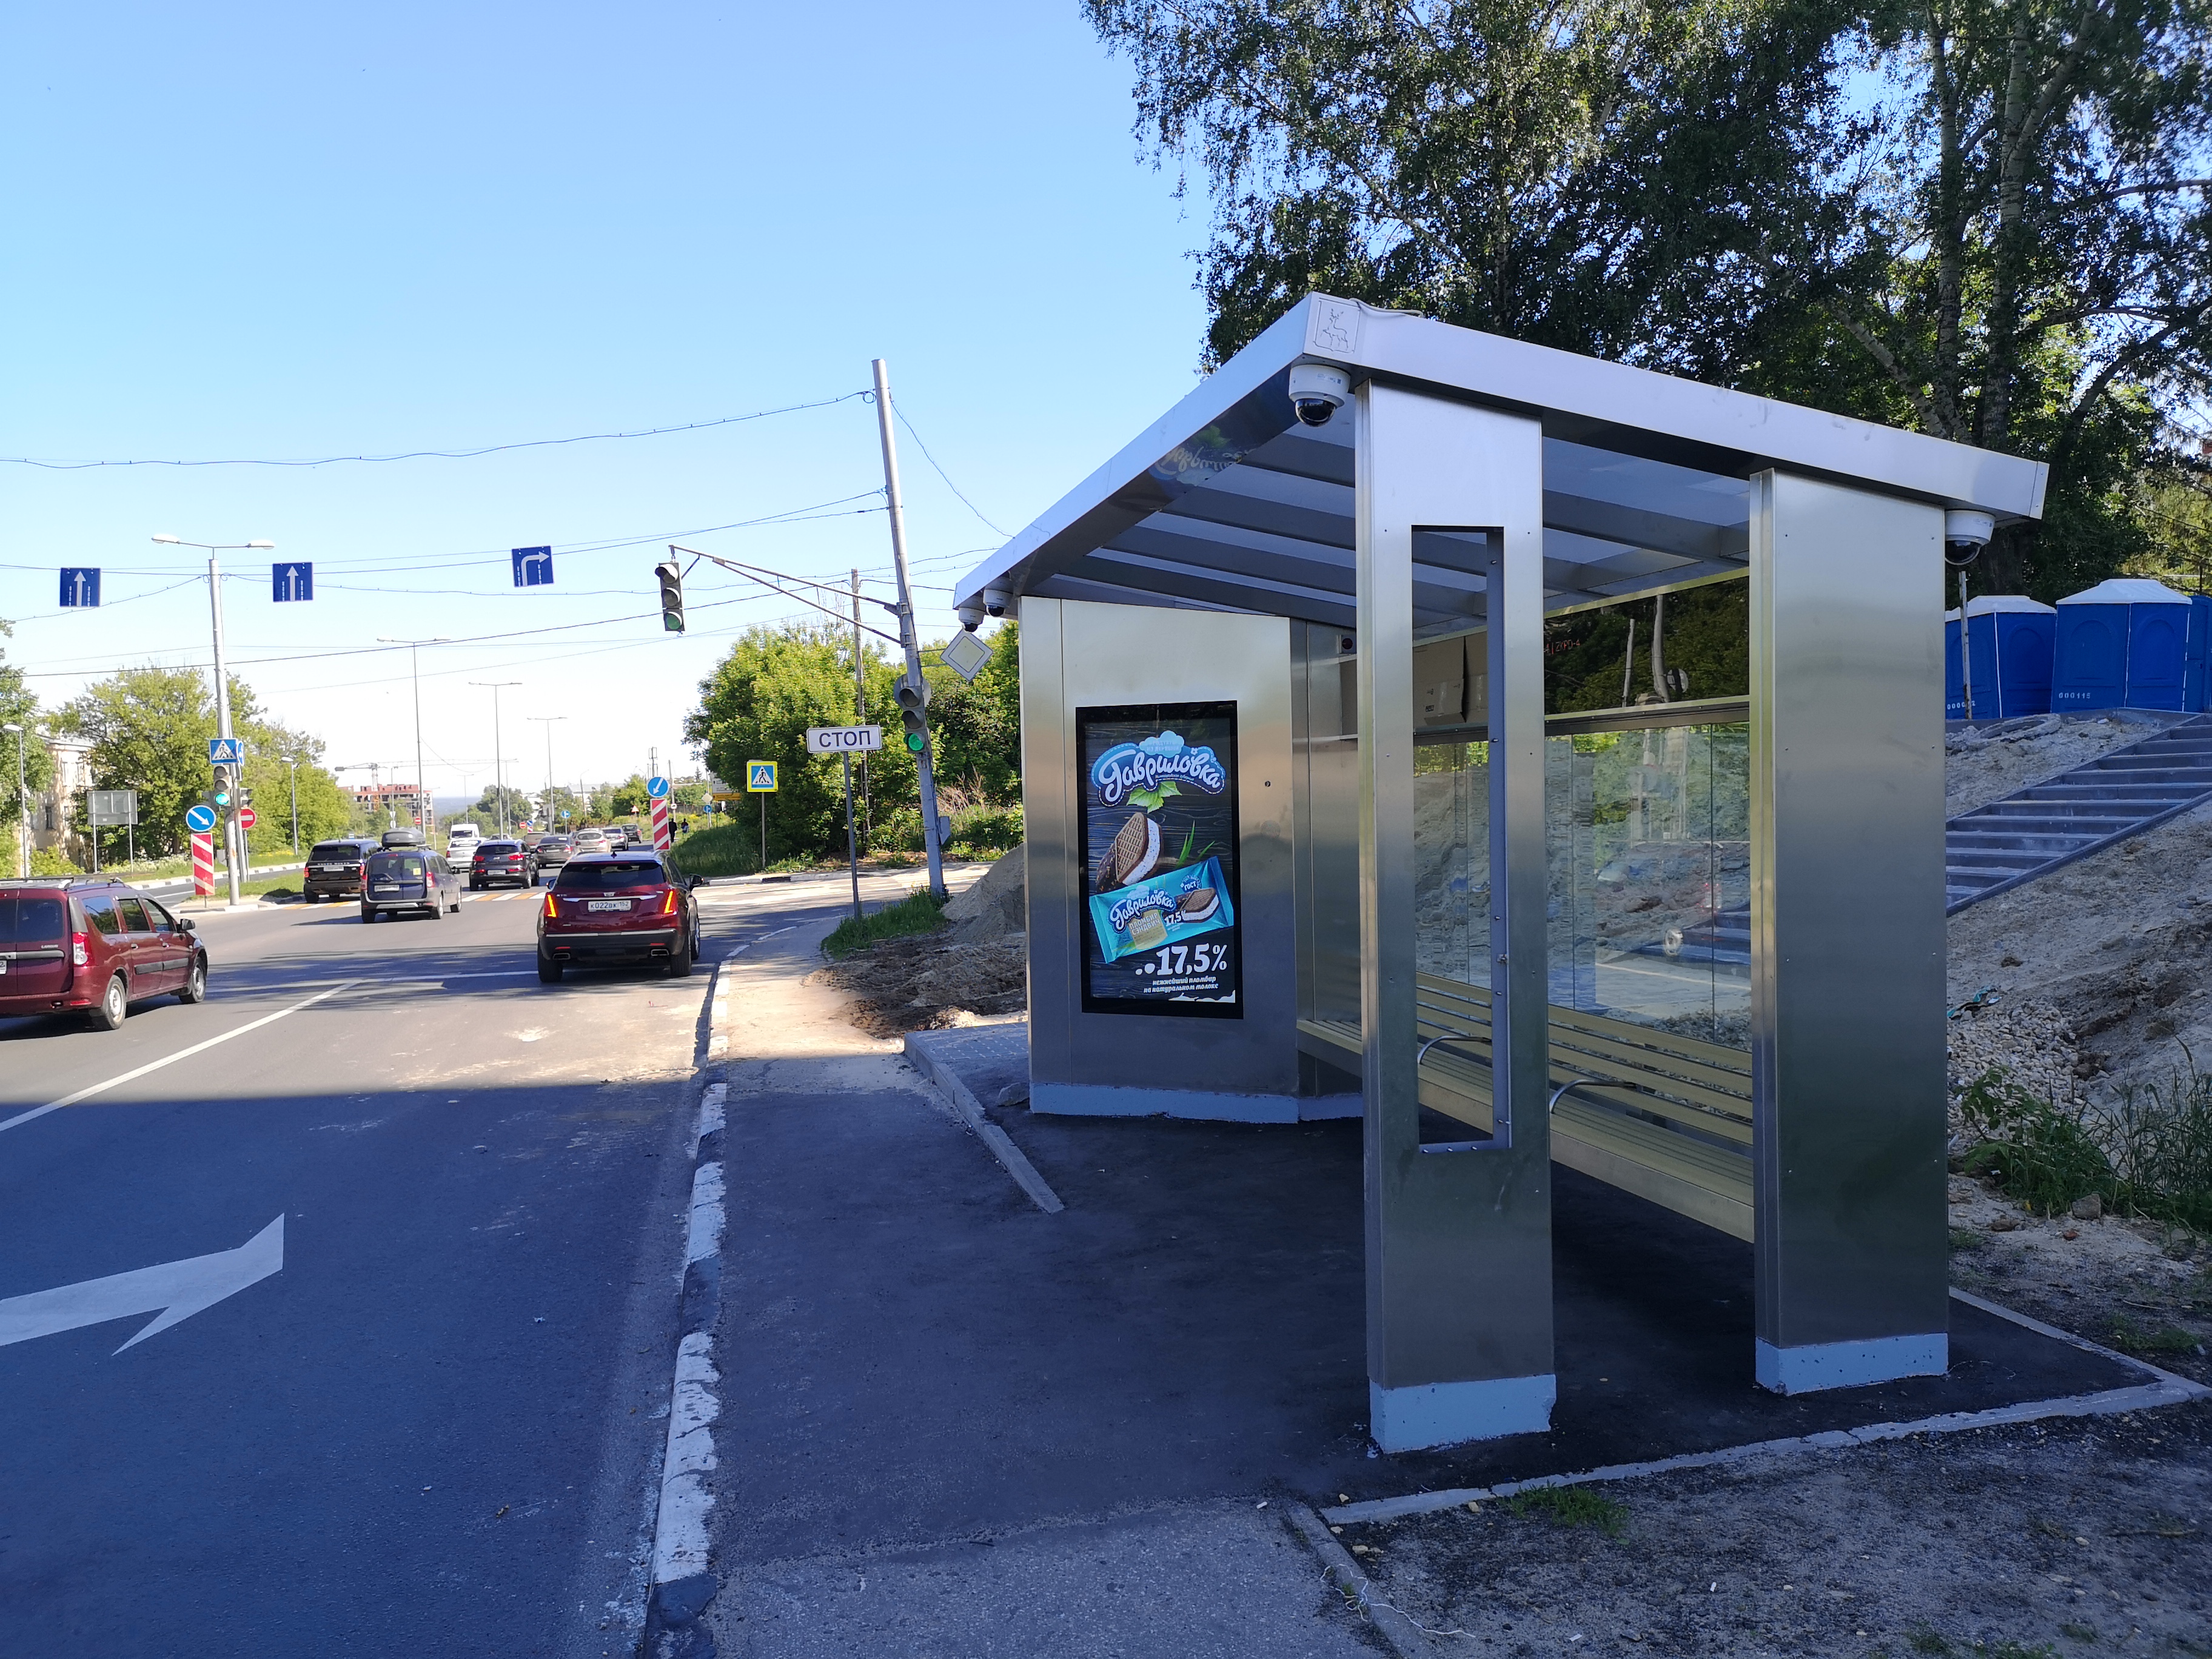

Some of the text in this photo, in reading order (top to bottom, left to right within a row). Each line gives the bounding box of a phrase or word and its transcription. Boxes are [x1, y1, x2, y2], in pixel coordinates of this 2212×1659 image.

[1947, 700, 1976, 710] 00002
[819, 730, 871, 747] СТОП
[1098, 749, 1221, 802] Гавриловка
[1110, 890, 1174, 930] Гавриловка
[1129, 913, 1158, 930] ПЛОМБИР
[1132, 919, 1161, 935] СЭНДВИЧ
